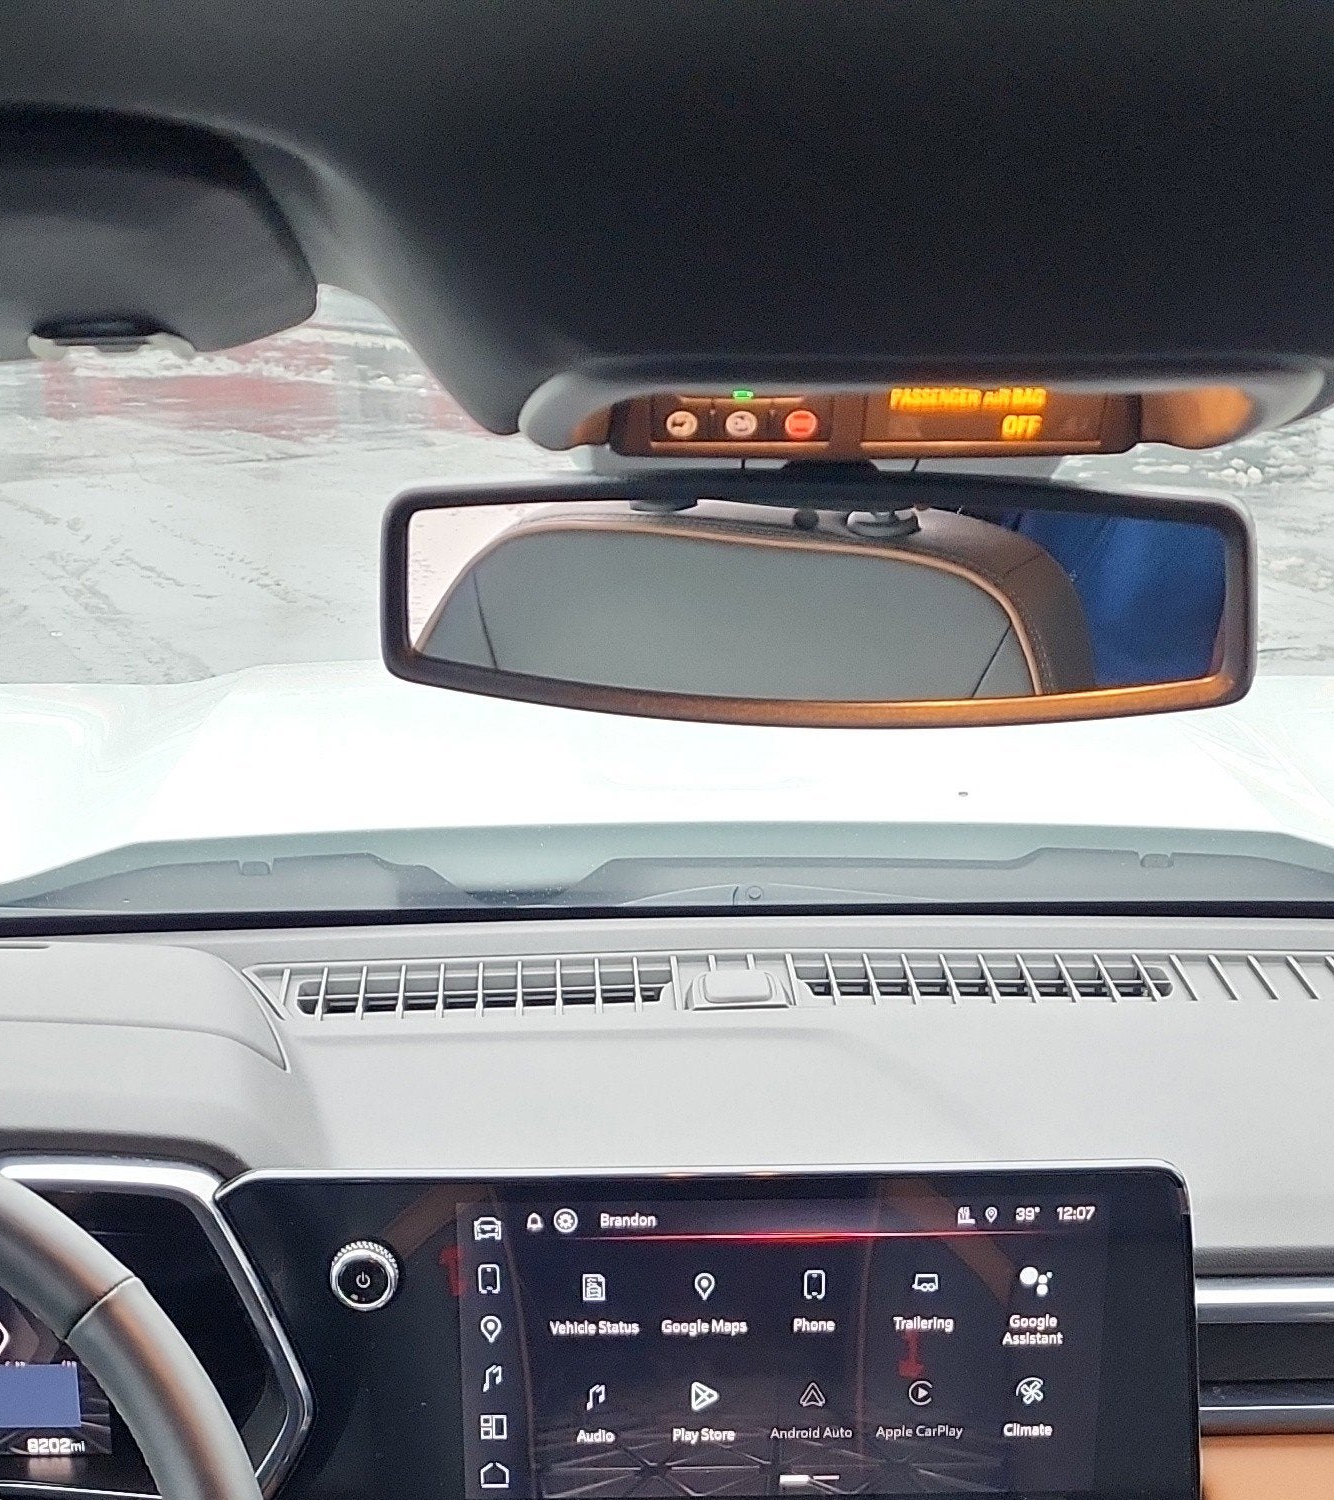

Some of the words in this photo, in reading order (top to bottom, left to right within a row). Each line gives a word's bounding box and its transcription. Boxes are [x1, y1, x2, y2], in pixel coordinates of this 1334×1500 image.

[891, 388, 982, 410] PASSENGER
[1002, 415, 1042, 439] OFF
[600, 1212, 656, 1228] Brandon
[1057, 1206, 1095, 1221] 12:07
[550, 1320, 595, 1336] Vehicle
[599, 1320, 640, 1335] Status
[662, 1318, 709, 1336] Google
[712, 1318, 747, 1336] Maps
[793, 1317, 835, 1333] Phone
[893, 1315, 954, 1333] Trailering
[1010, 1313, 1057, 1330] Google
[1002, 1330, 1062, 1346] Assistant
[576, 1429, 615, 1444] Audio
[672, 1426, 698, 1444] Play
[701, 1427, 735, 1442] Store
[770, 1425, 820, 1440] Android
[824, 1425, 853, 1440] Auto
[875, 1424, 913, 1440] Apple
[916, 1423, 964, 1440] CarPlay
[1003, 1422, 1052, 1437] Climate
